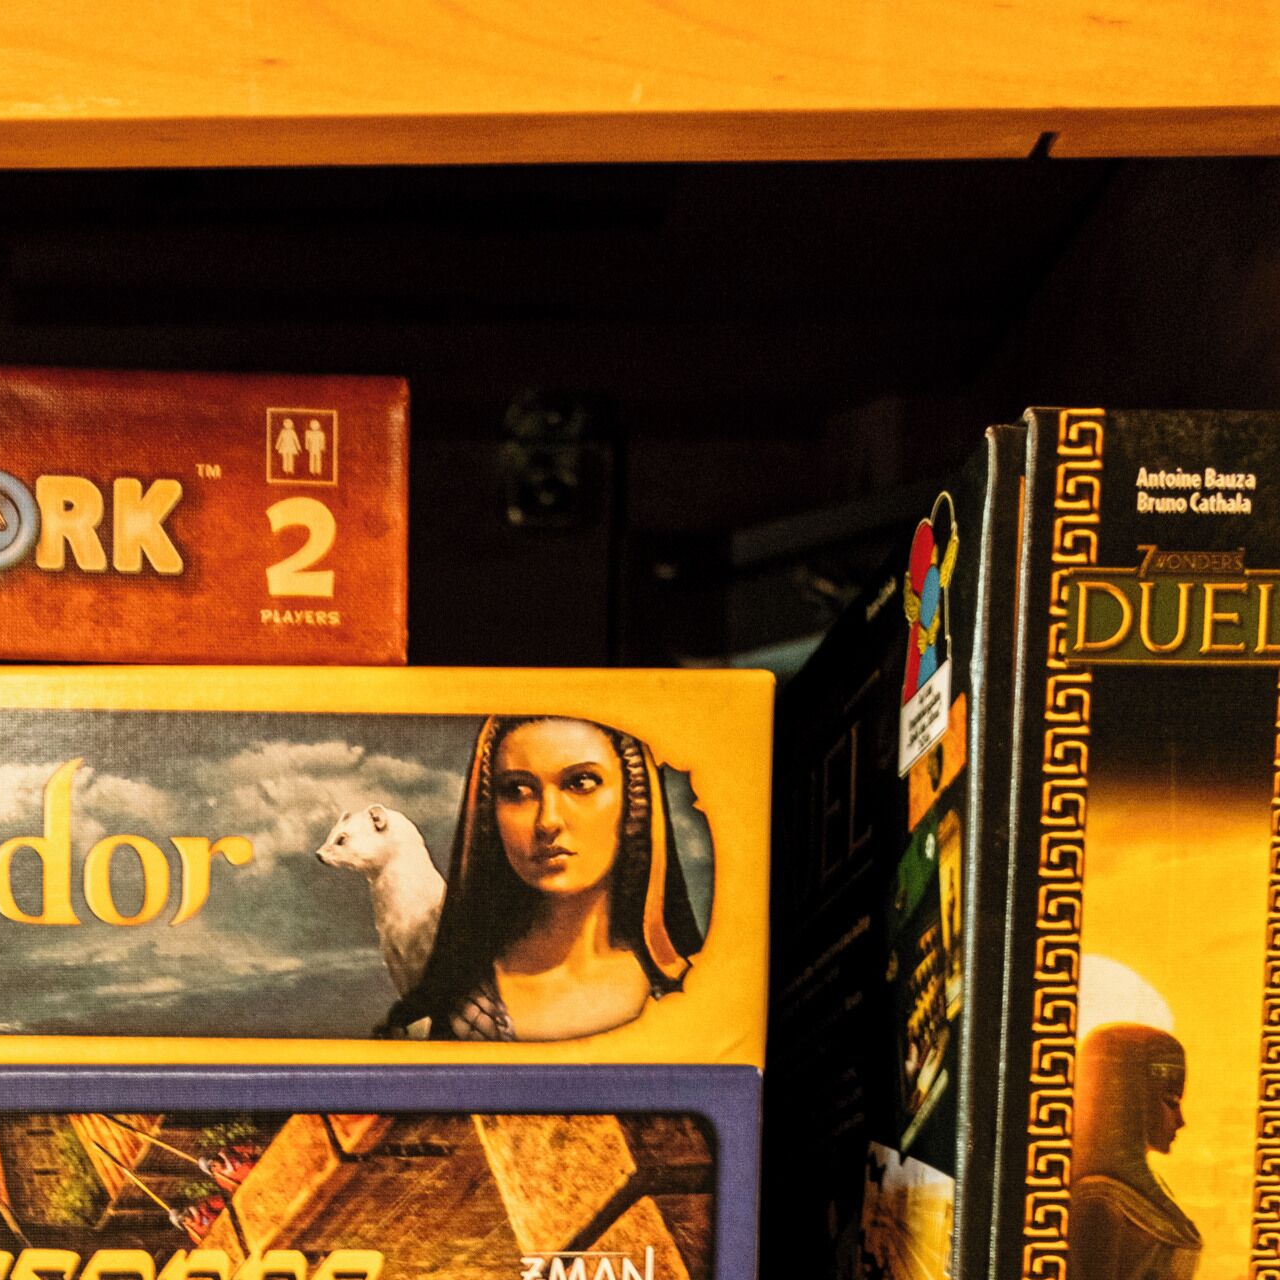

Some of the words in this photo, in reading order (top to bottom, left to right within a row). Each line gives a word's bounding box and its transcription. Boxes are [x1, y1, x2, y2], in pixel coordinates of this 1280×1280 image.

[1136, 467, 1202, 490] Antoine
[1204, 467, 1257, 490] Bauza
[1136, 491, 1187, 514] Bruno
[1190, 491, 1252, 514] Cathala
[266, 496, 337, 598] 2
[1137, 543, 1158, 578] 7
[1155, 553, 1243, 571] WONDERS
[260, 609, 342, 625] PLAYERS
[1073, 580, 1280, 654] DUEL
